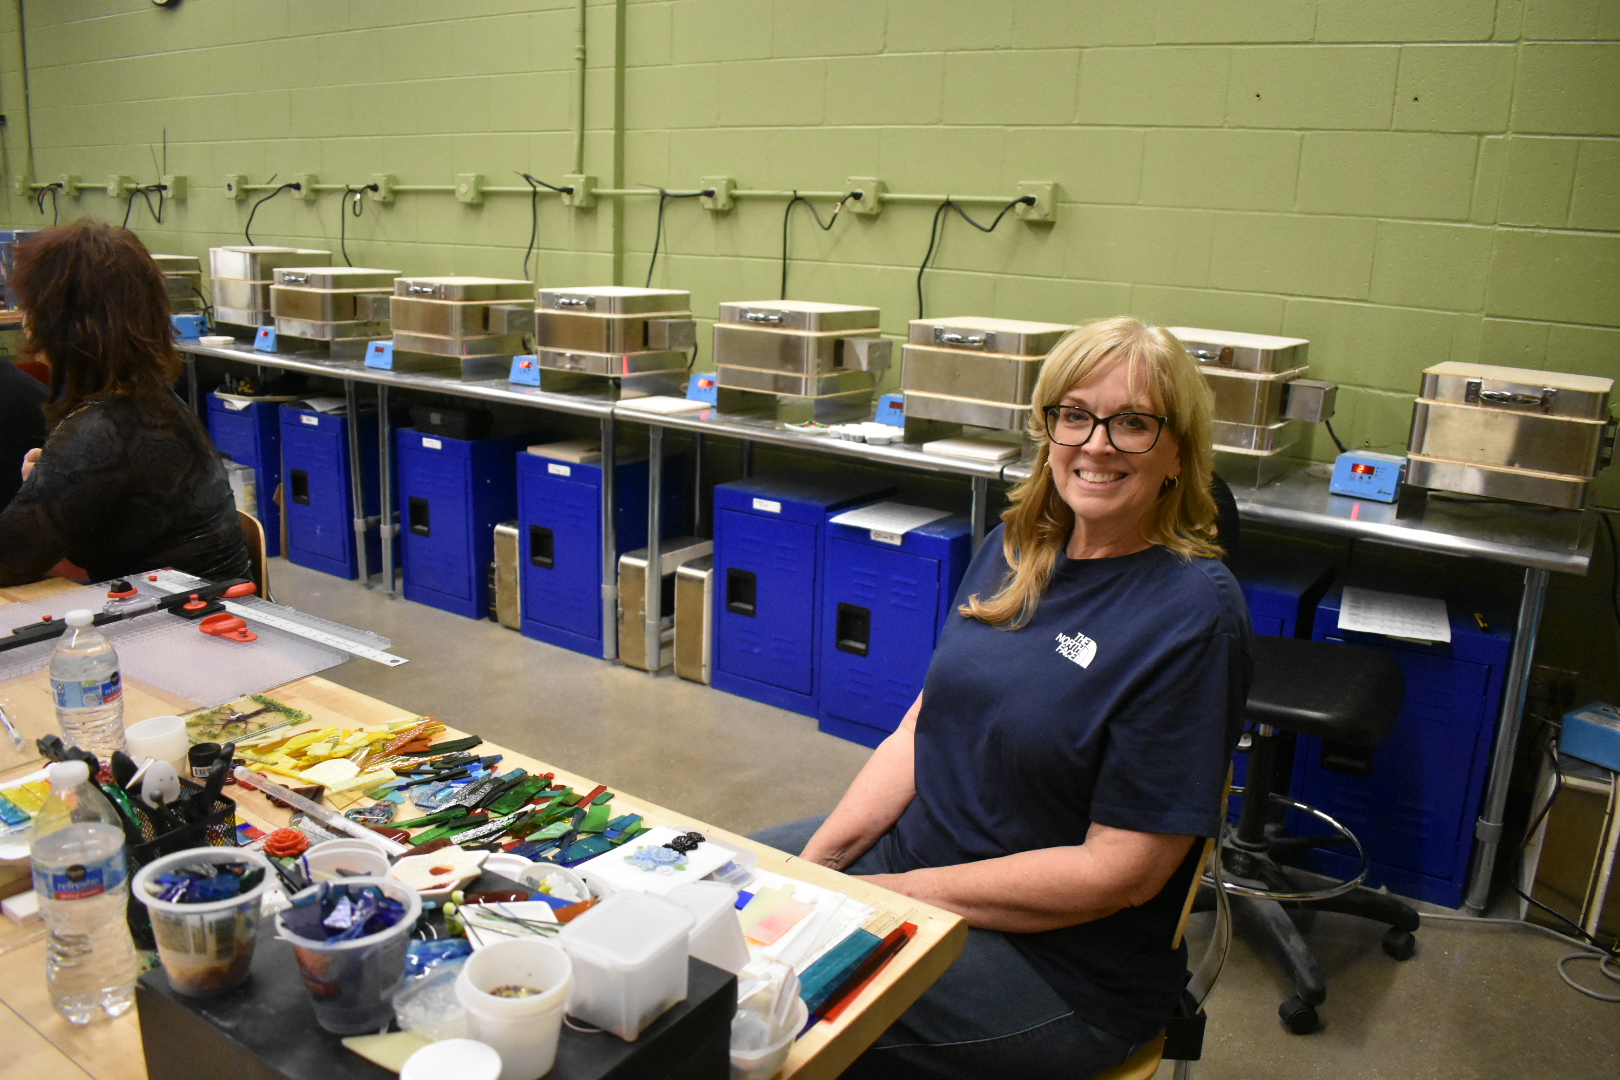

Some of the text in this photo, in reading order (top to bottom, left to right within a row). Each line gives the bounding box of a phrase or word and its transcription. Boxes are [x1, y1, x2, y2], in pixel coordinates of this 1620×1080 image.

[1055, 632, 1085, 654] NORTH
[1074, 632, 1091, 646] THE
[1055, 643, 1079, 661] FACE
